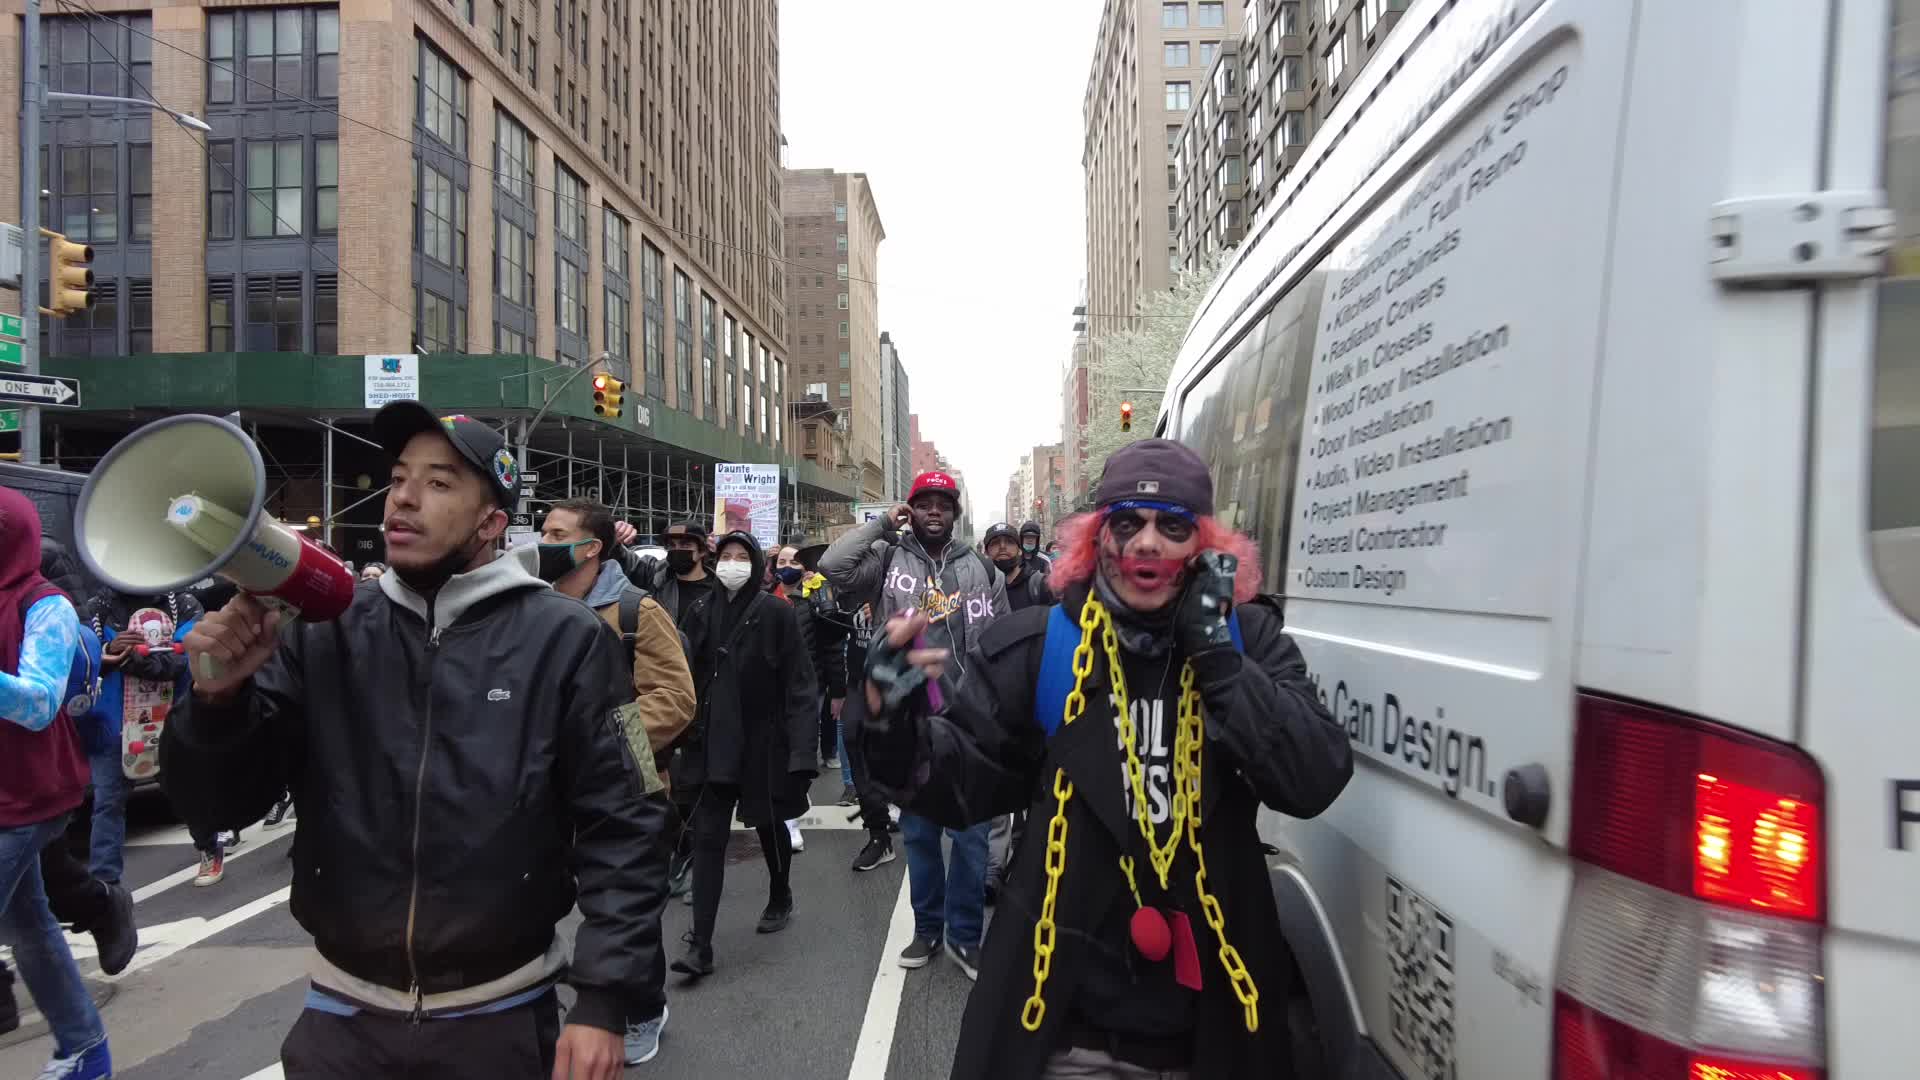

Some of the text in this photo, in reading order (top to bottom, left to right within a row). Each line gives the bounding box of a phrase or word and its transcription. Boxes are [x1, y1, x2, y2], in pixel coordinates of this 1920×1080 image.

[1501, 65, 1568, 134] Shop
[1339, 231, 1411, 299] Bathrooms
[1428, 183, 1463, 231] Full
[1466, 140, 1528, 201] Reno
[1334, 286, 1382, 330] Kitchen
[1386, 228, 1461, 294] Cabinets
[1330, 276, 1446, 363] Radiator Covers
[5, 381, 67, 397] ONE WAY
[1322, 324, 1509, 426] Wood Floor Installation
[1326, 322, 1434, 393] Walk In Closets
[637, 404, 650, 427] DIG
[1318, 399, 1434, 459] Door Installation
[718, 463, 750, 473] Daunte
[743, 473, 776, 485] Wright
[1313, 416, 1512, 490] Audio, Video Installation
[1311, 469, 1469, 524] Project Management
[1307, 521, 1448, 555] General Contractor
[1305, 564, 1406, 596] Custom Design
[1334, 680, 1374, 747] Can
[1383, 692, 1495, 798] Design.
